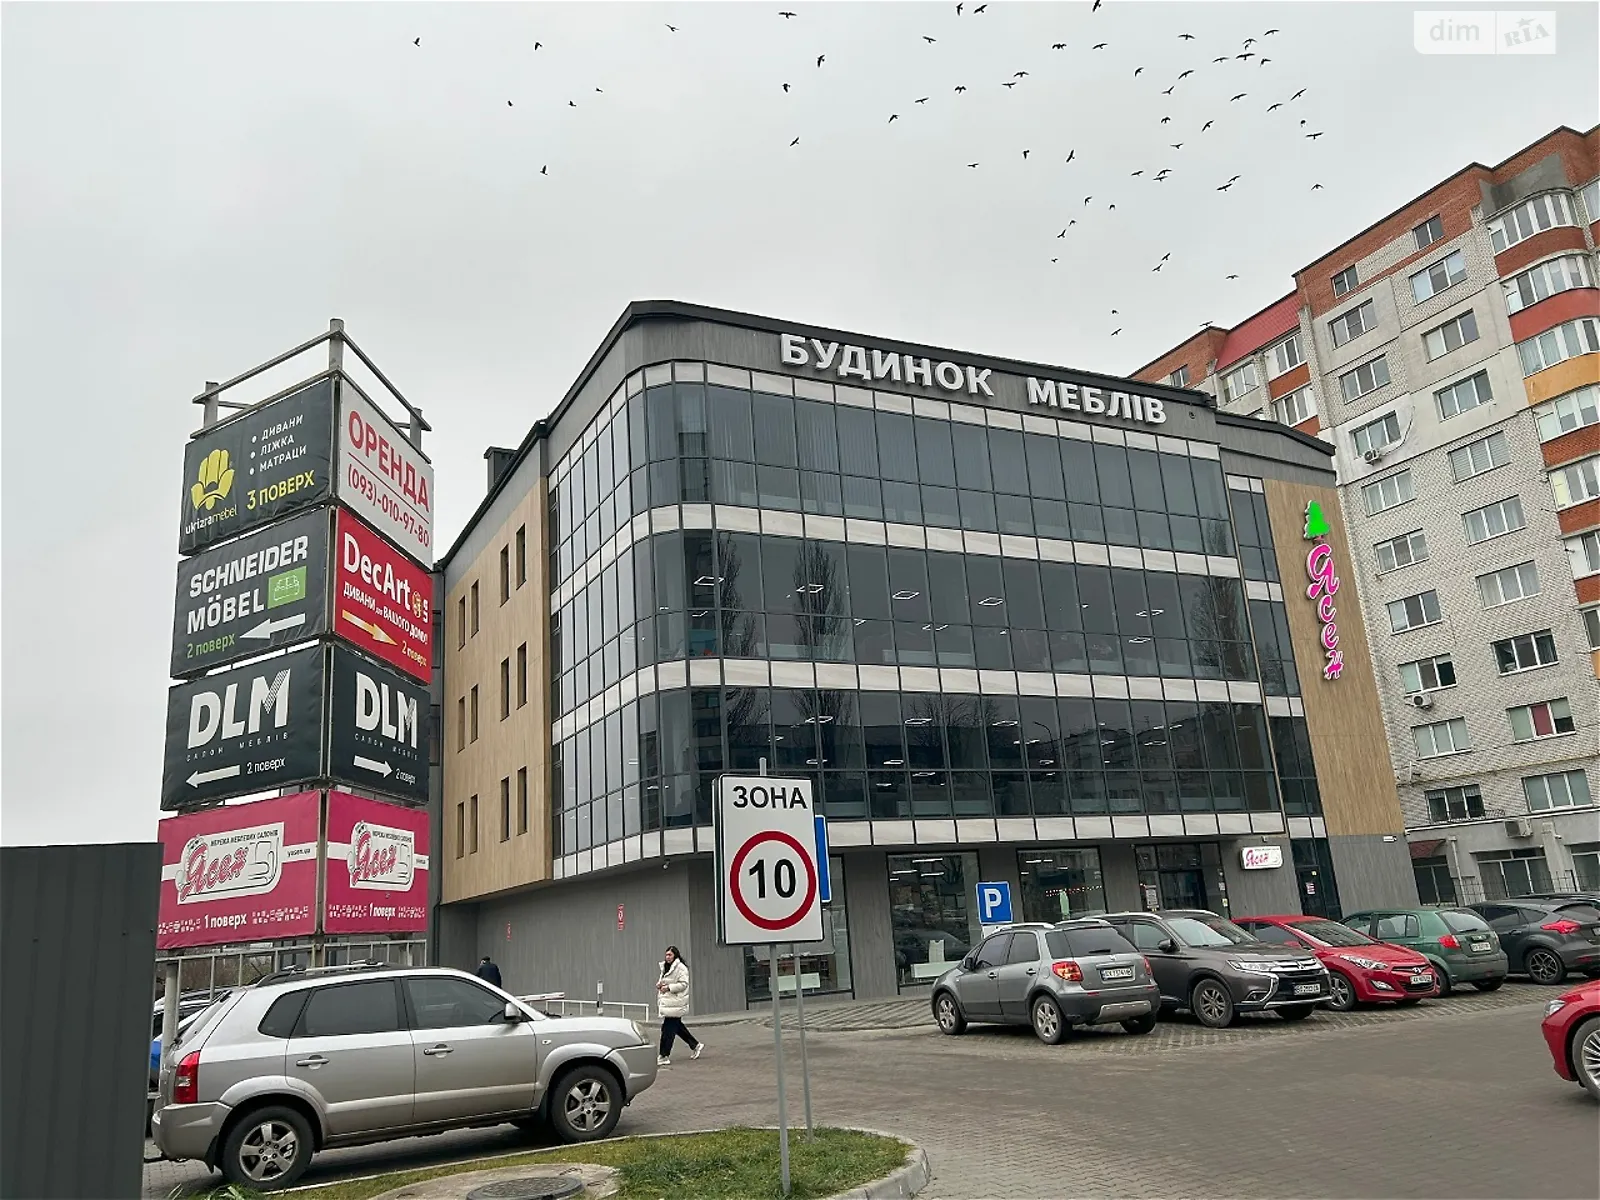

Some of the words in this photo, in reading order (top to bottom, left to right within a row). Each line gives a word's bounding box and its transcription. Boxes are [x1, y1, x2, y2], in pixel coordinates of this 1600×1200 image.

[780, 333, 995, 397] БУДИНОК
[1026, 376, 1168, 425] МЕБЛІВ
[261, 414, 304, 441] ДИВАНИ
[259, 444, 307, 472] МАТРАЦИ
[260, 434, 295, 456] ЛІЖКА
[348, 410, 430, 513] ОРЕНДА
[246, 489, 256, 510] 3
[259, 469, 315, 505] ПОВЕРХ
[347, 463, 430, 547] (093)-010-97-80
[189, 535, 309, 598] SCHNEIDER
[343, 580, 376, 611] ДИВАНИ
[187, 588, 265, 635] MÖBEL
[187, 643, 194, 659] 2
[195, 633, 236, 656] поверх
[401, 640, 407, 655] 2
[187, 668, 291, 749] DLM
[355, 671, 417, 749] DLM
[246, 761, 253, 775] 2
[254, 757, 286, 771] поверх
[732, 785, 808, 809] ЗОНА
[749, 859, 797, 899] 10
[983, 888, 1002, 918] P
[204, 914, 210, 928] 1
[210, 913, 247, 930] поверх
